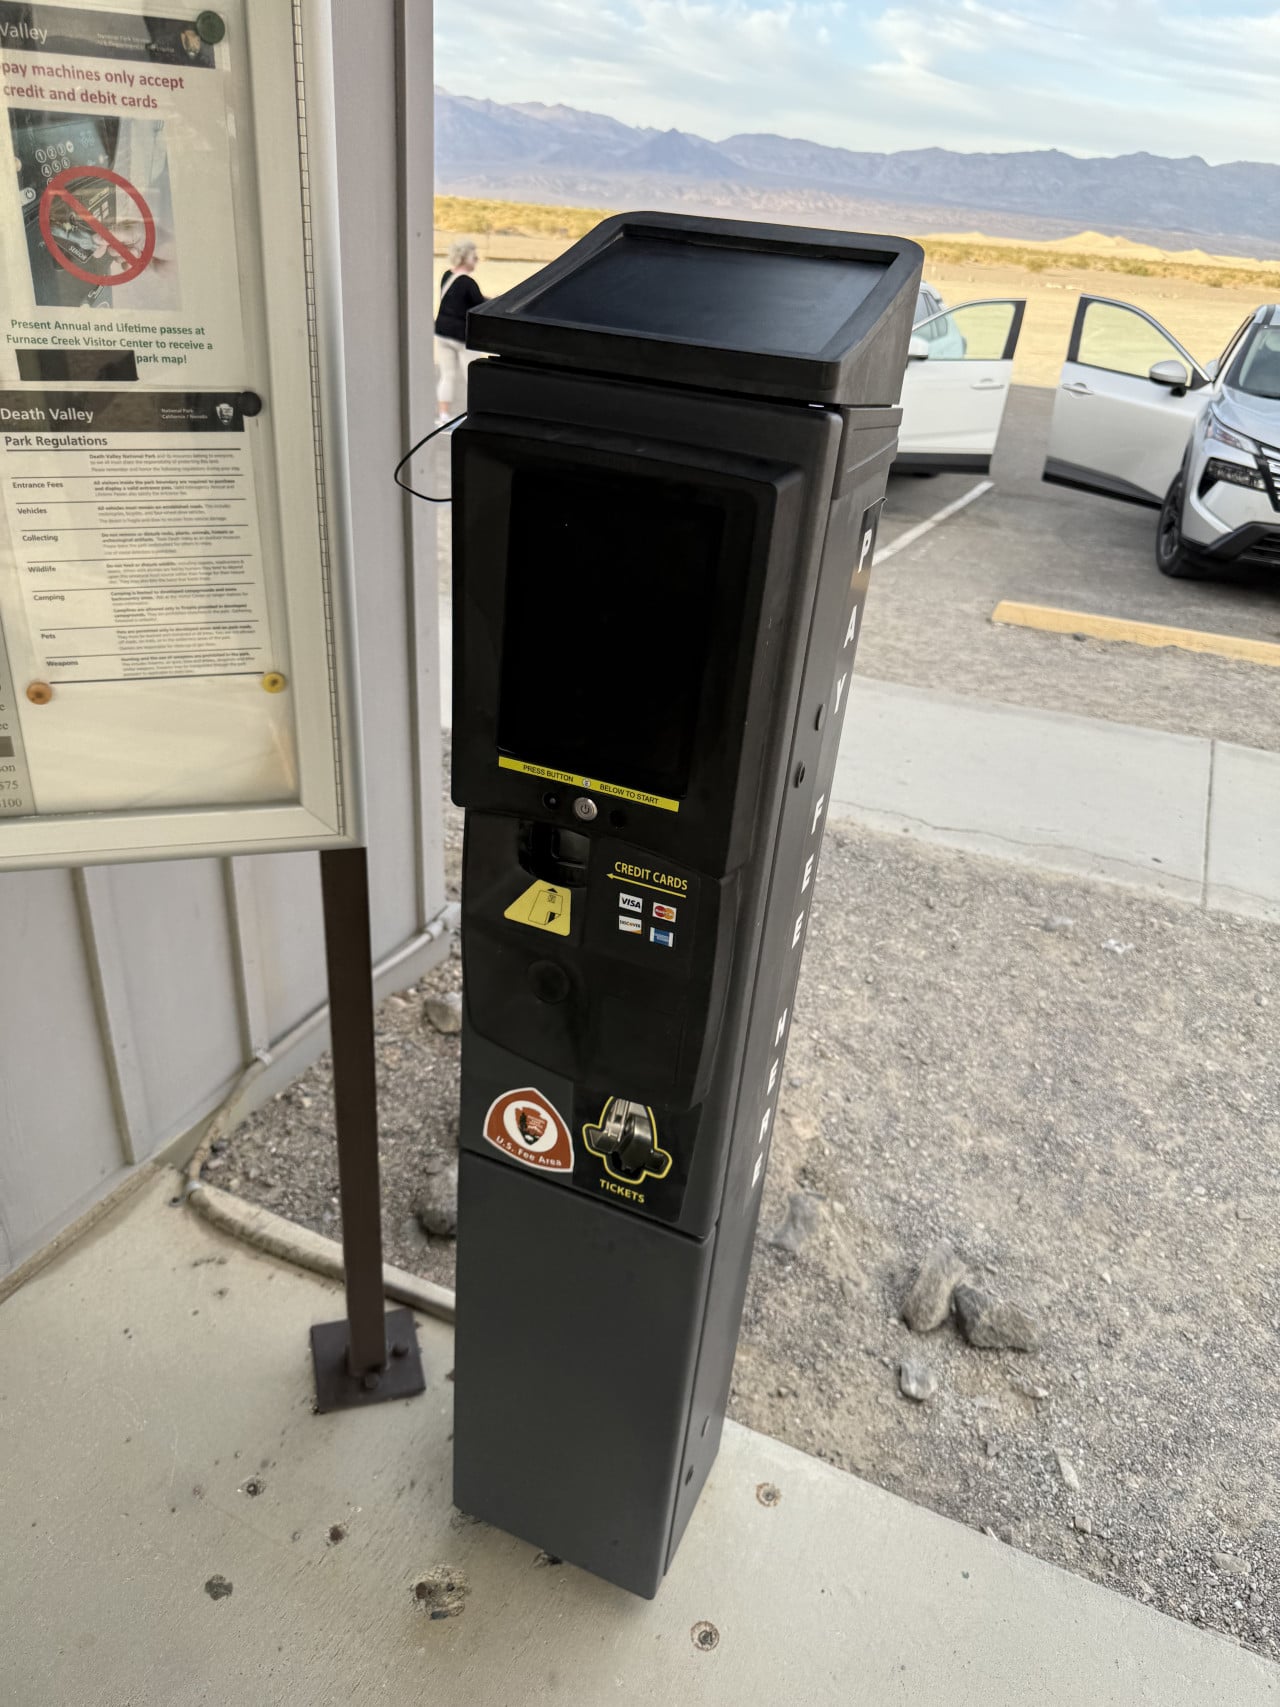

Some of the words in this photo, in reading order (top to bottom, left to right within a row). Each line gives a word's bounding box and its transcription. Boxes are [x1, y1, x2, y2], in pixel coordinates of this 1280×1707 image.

[0, 22, 47, 45] Valley
[32, 65, 100, 81] machines
[105, 71, 135, 87] only
[139, 74, 184, 91] accept
[3, 84, 44, 99] credit
[49, 88, 76, 101] and
[80, 90, 116, 105] debit
[121, 94, 157, 109] cards
[11, 319, 51, 331] Present
[54, 321, 91, 332] Annual
[94, 322, 113, 333] and
[116, 323, 157, 334] Lifetime
[160, 325, 193, 336] passes
[195, 327, 205, 335] at
[6, 335, 48, 345] Furnace
[51, 336, 80, 346] Creek
[83, 337, 116, 347] Visitor
[120, 338, 153, 348] Center
[156, 340, 167, 349] to
[169, 341, 205, 350] receive
[136, 354, 158, 364] park
[161, 354, 187, 365] map!
[0, 408, 45, 420] Death
[49, 408, 94, 423] Valley
[5, 436, 32, 446] Park
[36, 436, 108, 449] Regulations
[12, 481, 45, 489] Entrance
[47, 480, 63, 488] Fees
[17, 507, 47, 515] Vehicles
[22, 534, 58, 543] Collecting
[28, 565, 56, 573] Wildlife
[33, 593, 65, 603] Camping
[46, 659, 78, 668] Weapons
[523, 764, 545, 776] PRESS
[546, 770, 574, 783] BUTTON
[600, 784, 624, 795] BELOW
[626, 790, 636, 799] TO
[636, 792, 659, 805] START
[0, 798, 22, 808] 100
[615, 861, 651, 881] CREDIT
[652, 871, 688, 891] CARDS
[621, 896, 641, 909] VISA
[495, 1135, 514, 1152] U.S.
[518, 1148, 535, 1161] Fee
[538, 1155, 562, 1167] Area
[600, 1179, 645, 1203] TICKETS
